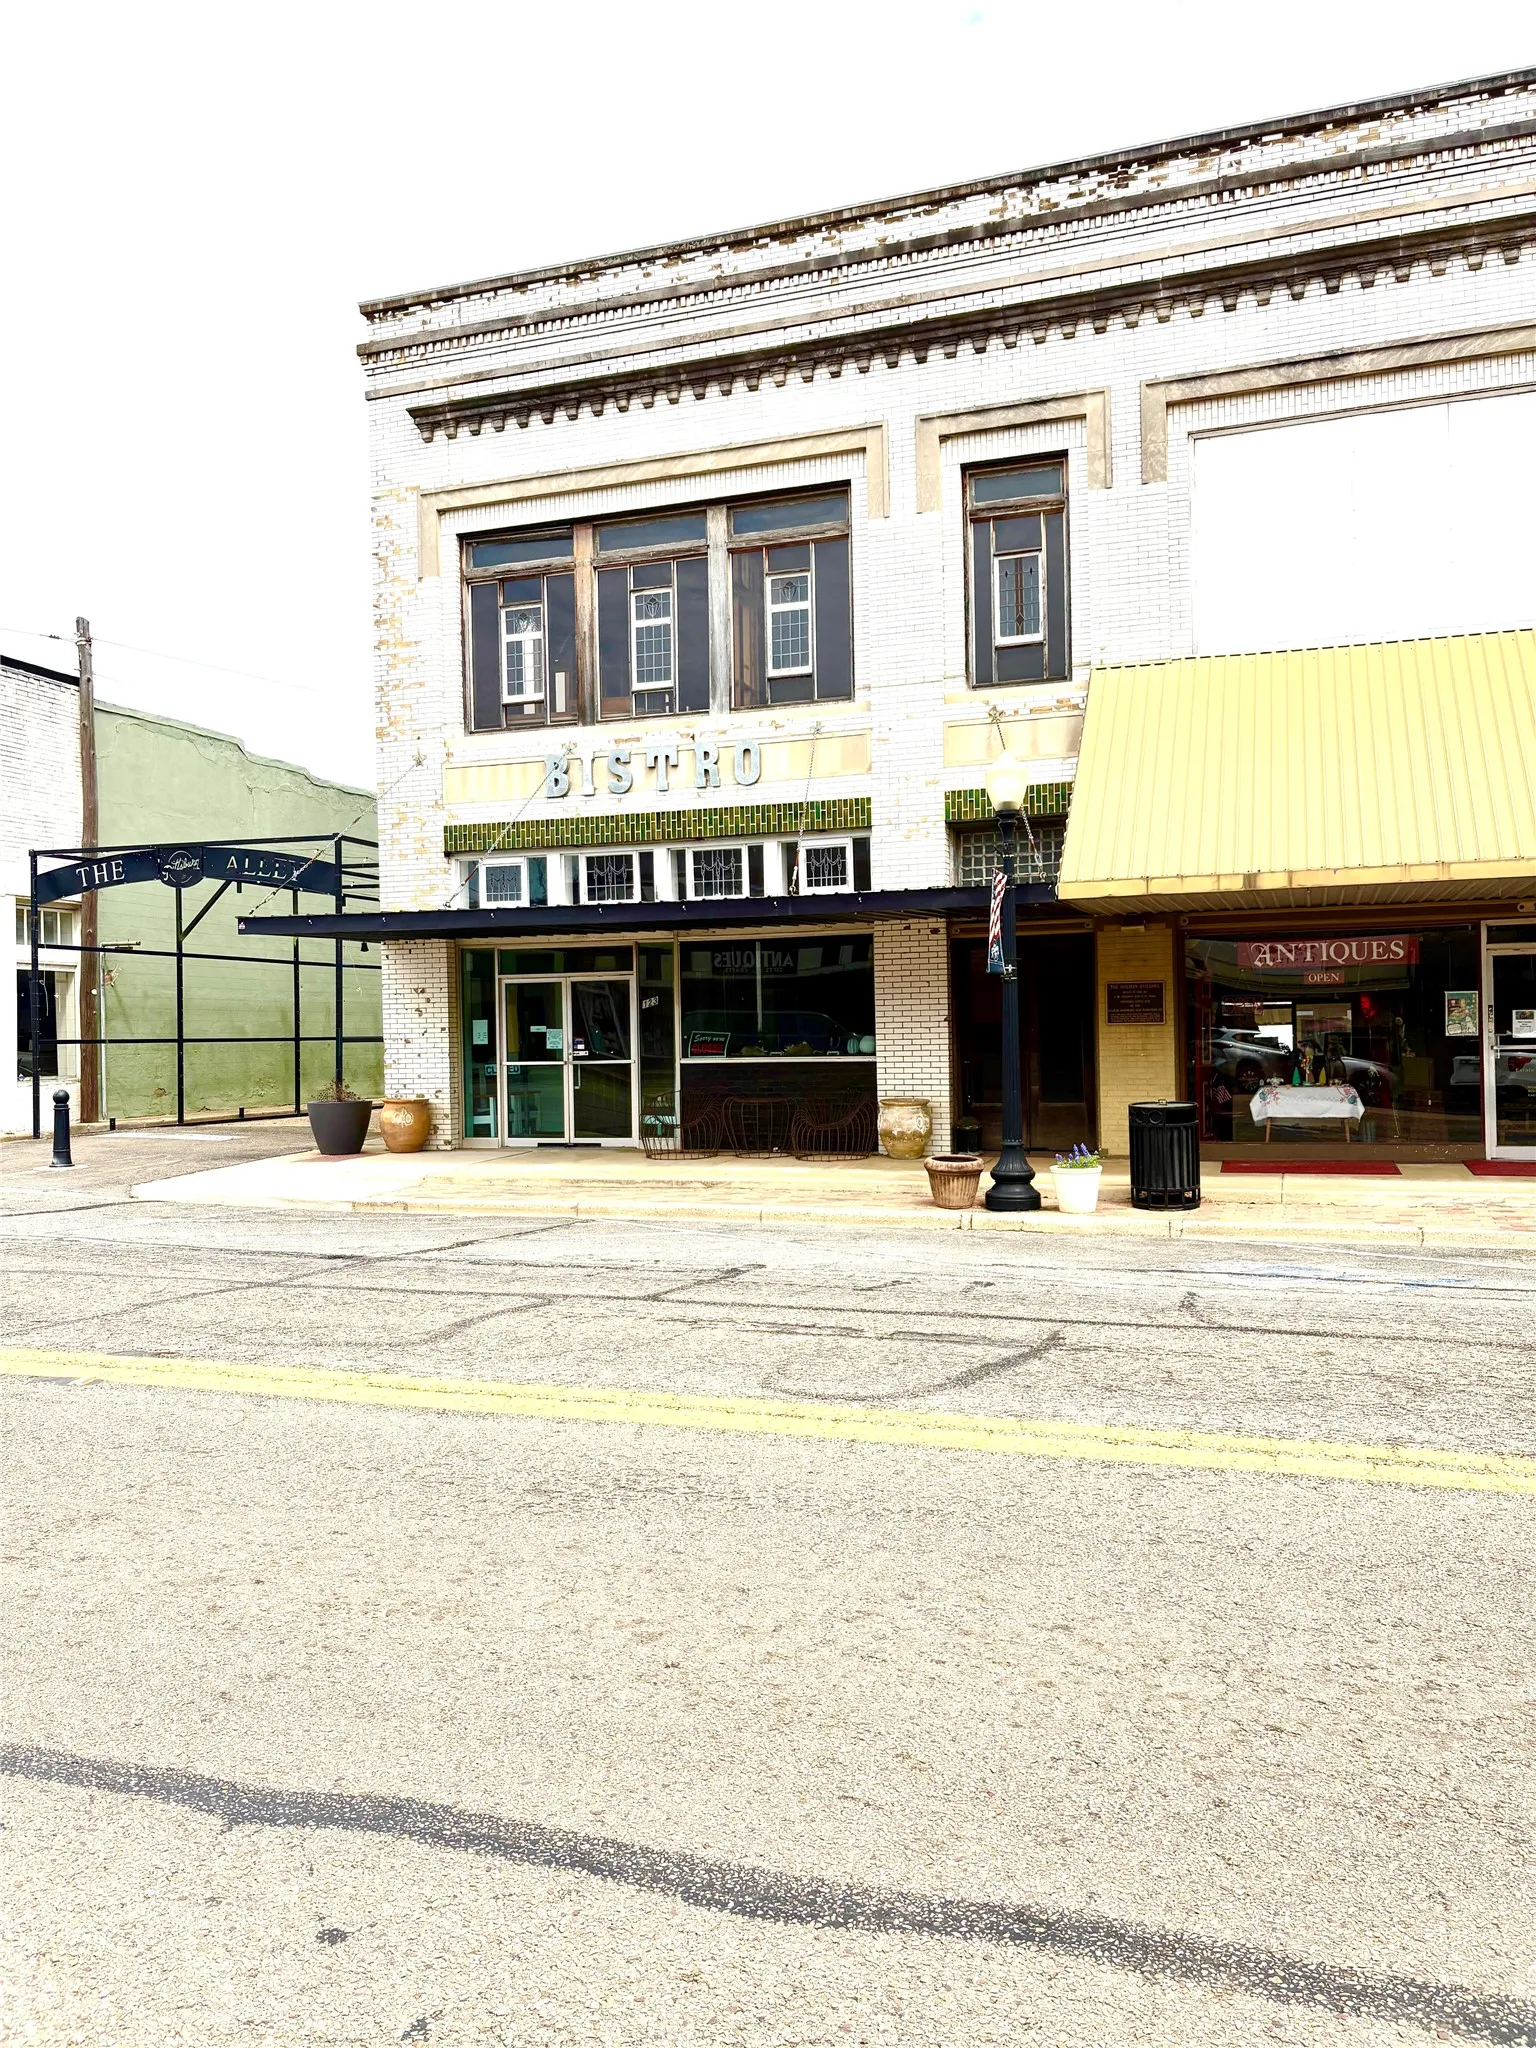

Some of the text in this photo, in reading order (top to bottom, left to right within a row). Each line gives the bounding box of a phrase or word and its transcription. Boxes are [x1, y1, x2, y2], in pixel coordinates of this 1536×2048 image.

[544, 738, 761, 798] BISTRO
[76, 860, 126, 888] THE
[226, 855, 305, 882] ALLEY
[1250, 940, 1405, 967] ANTIQUES
[1308, 972, 1340, 983] OPEN
[643, 996, 659, 1008] 123
[486, 1065, 520, 1075] CLED
